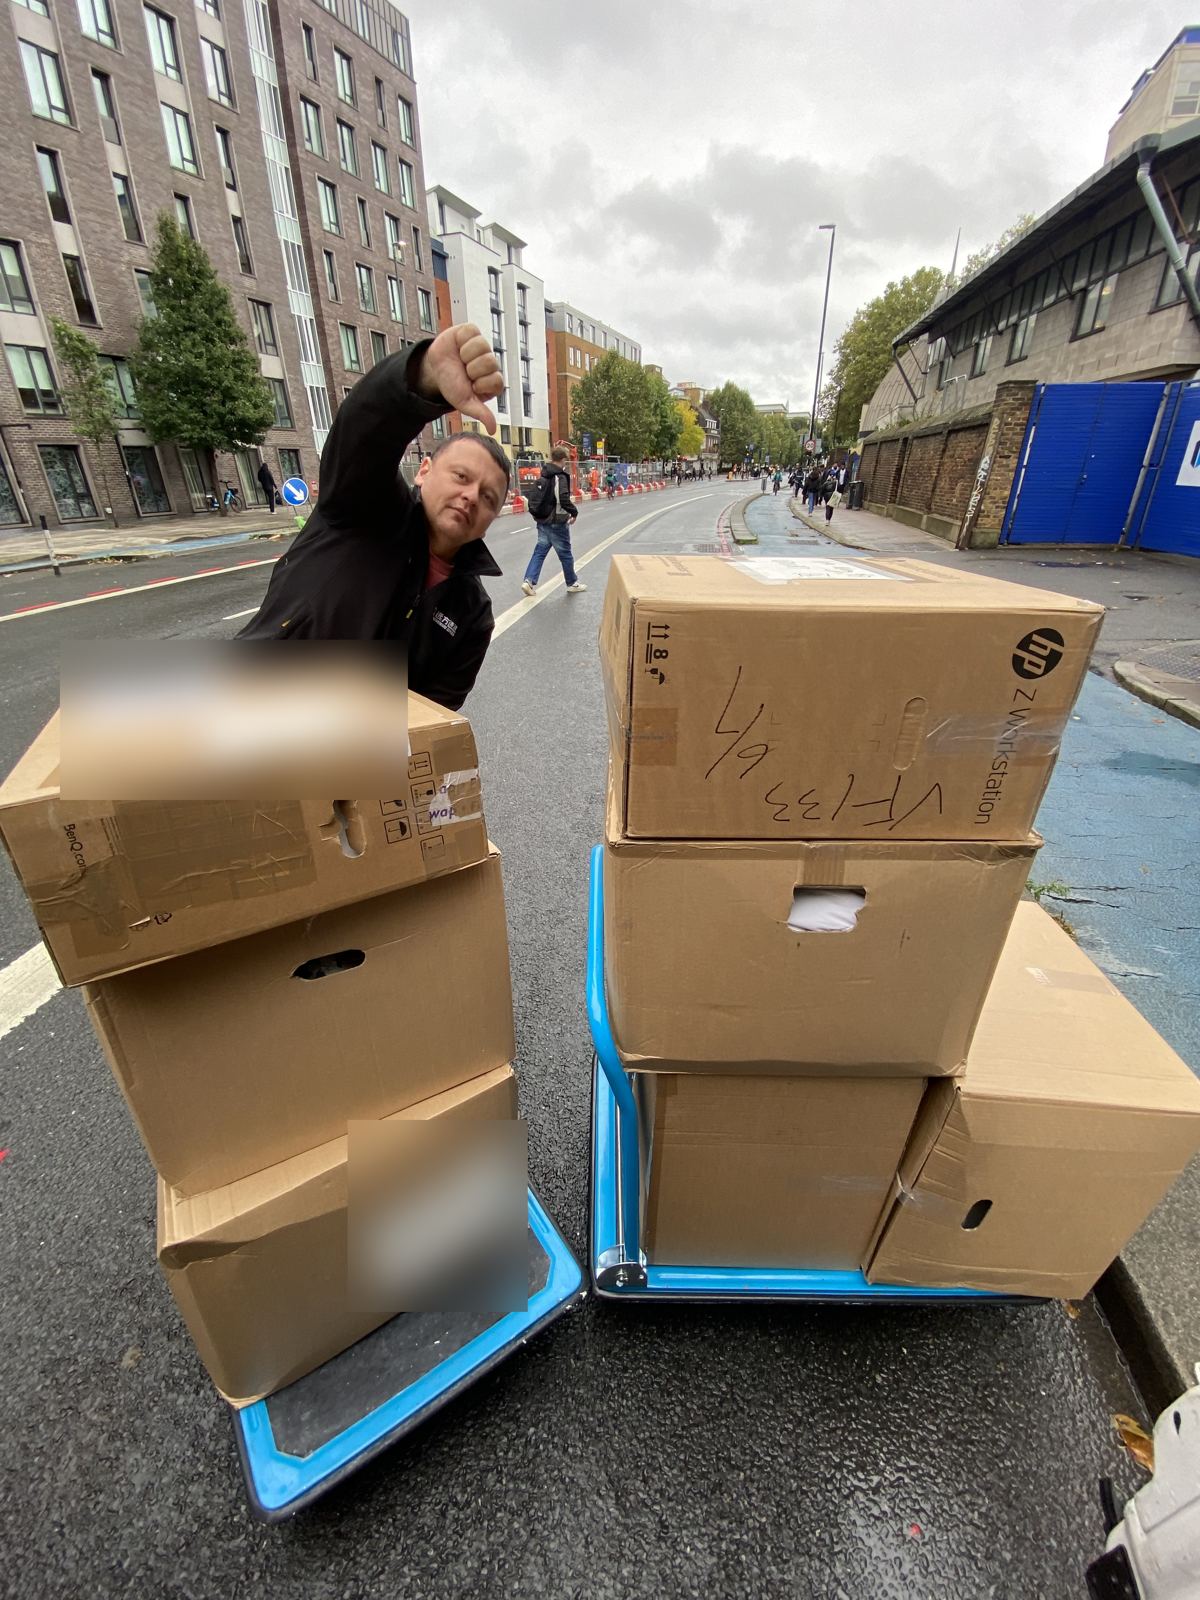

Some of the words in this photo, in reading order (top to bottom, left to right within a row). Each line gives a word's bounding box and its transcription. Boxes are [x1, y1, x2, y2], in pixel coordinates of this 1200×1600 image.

[653, 648, 669, 660] 8
[1012, 629, 1065, 680] hp
[1012, 687, 1037, 702] Z
